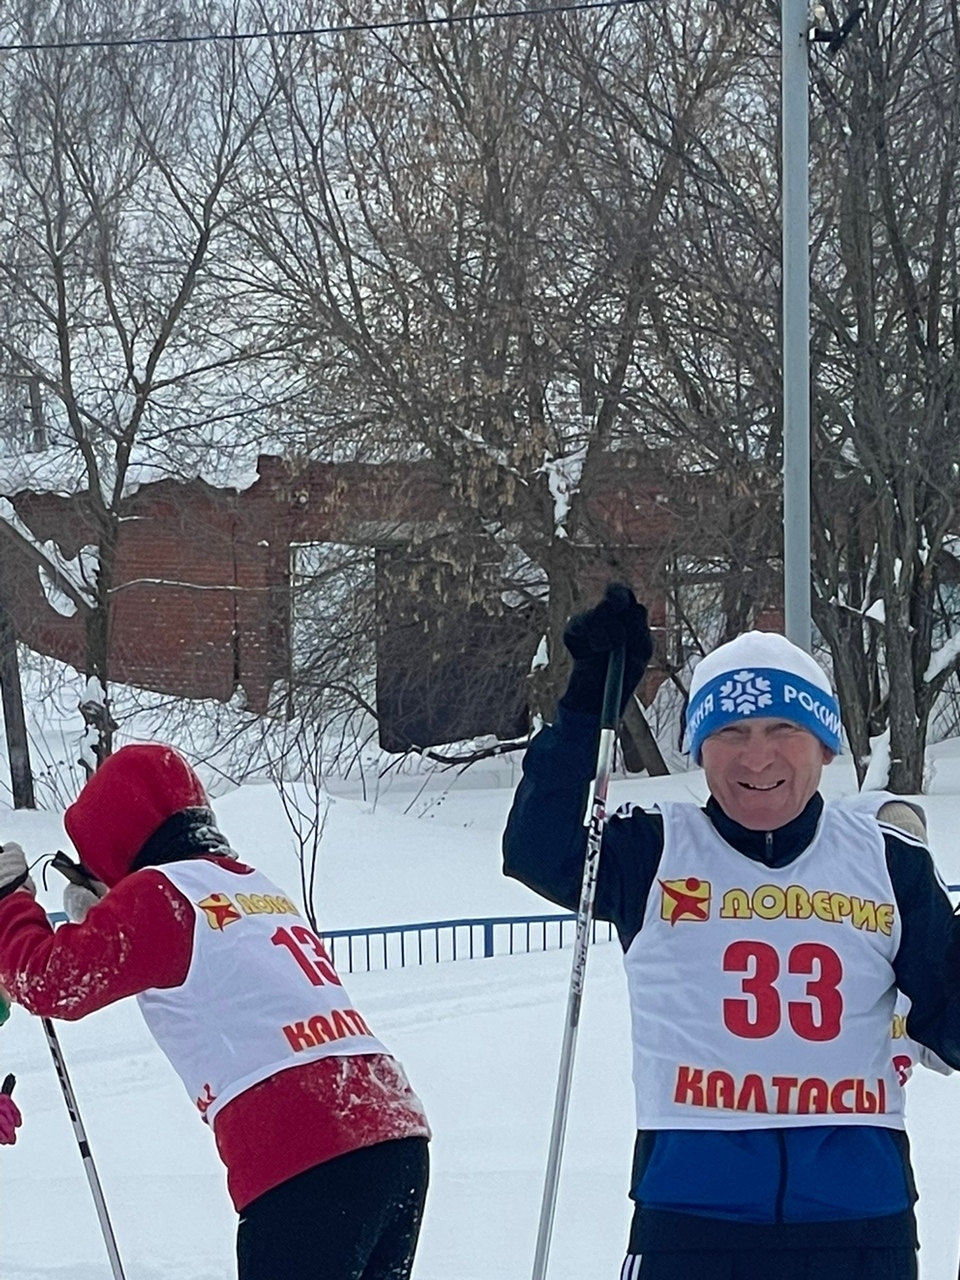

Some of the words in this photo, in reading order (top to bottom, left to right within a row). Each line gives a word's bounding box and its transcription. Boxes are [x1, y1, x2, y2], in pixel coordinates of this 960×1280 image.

[720, 884, 895, 937] ДОВЕРИЕ
[270, 926, 343, 987] 13
[722, 940, 843, 1042] 33
[282, 1009, 376, 1053] КАЛТ
[674, 1065, 886, 1115] КАЛТАСЫ
